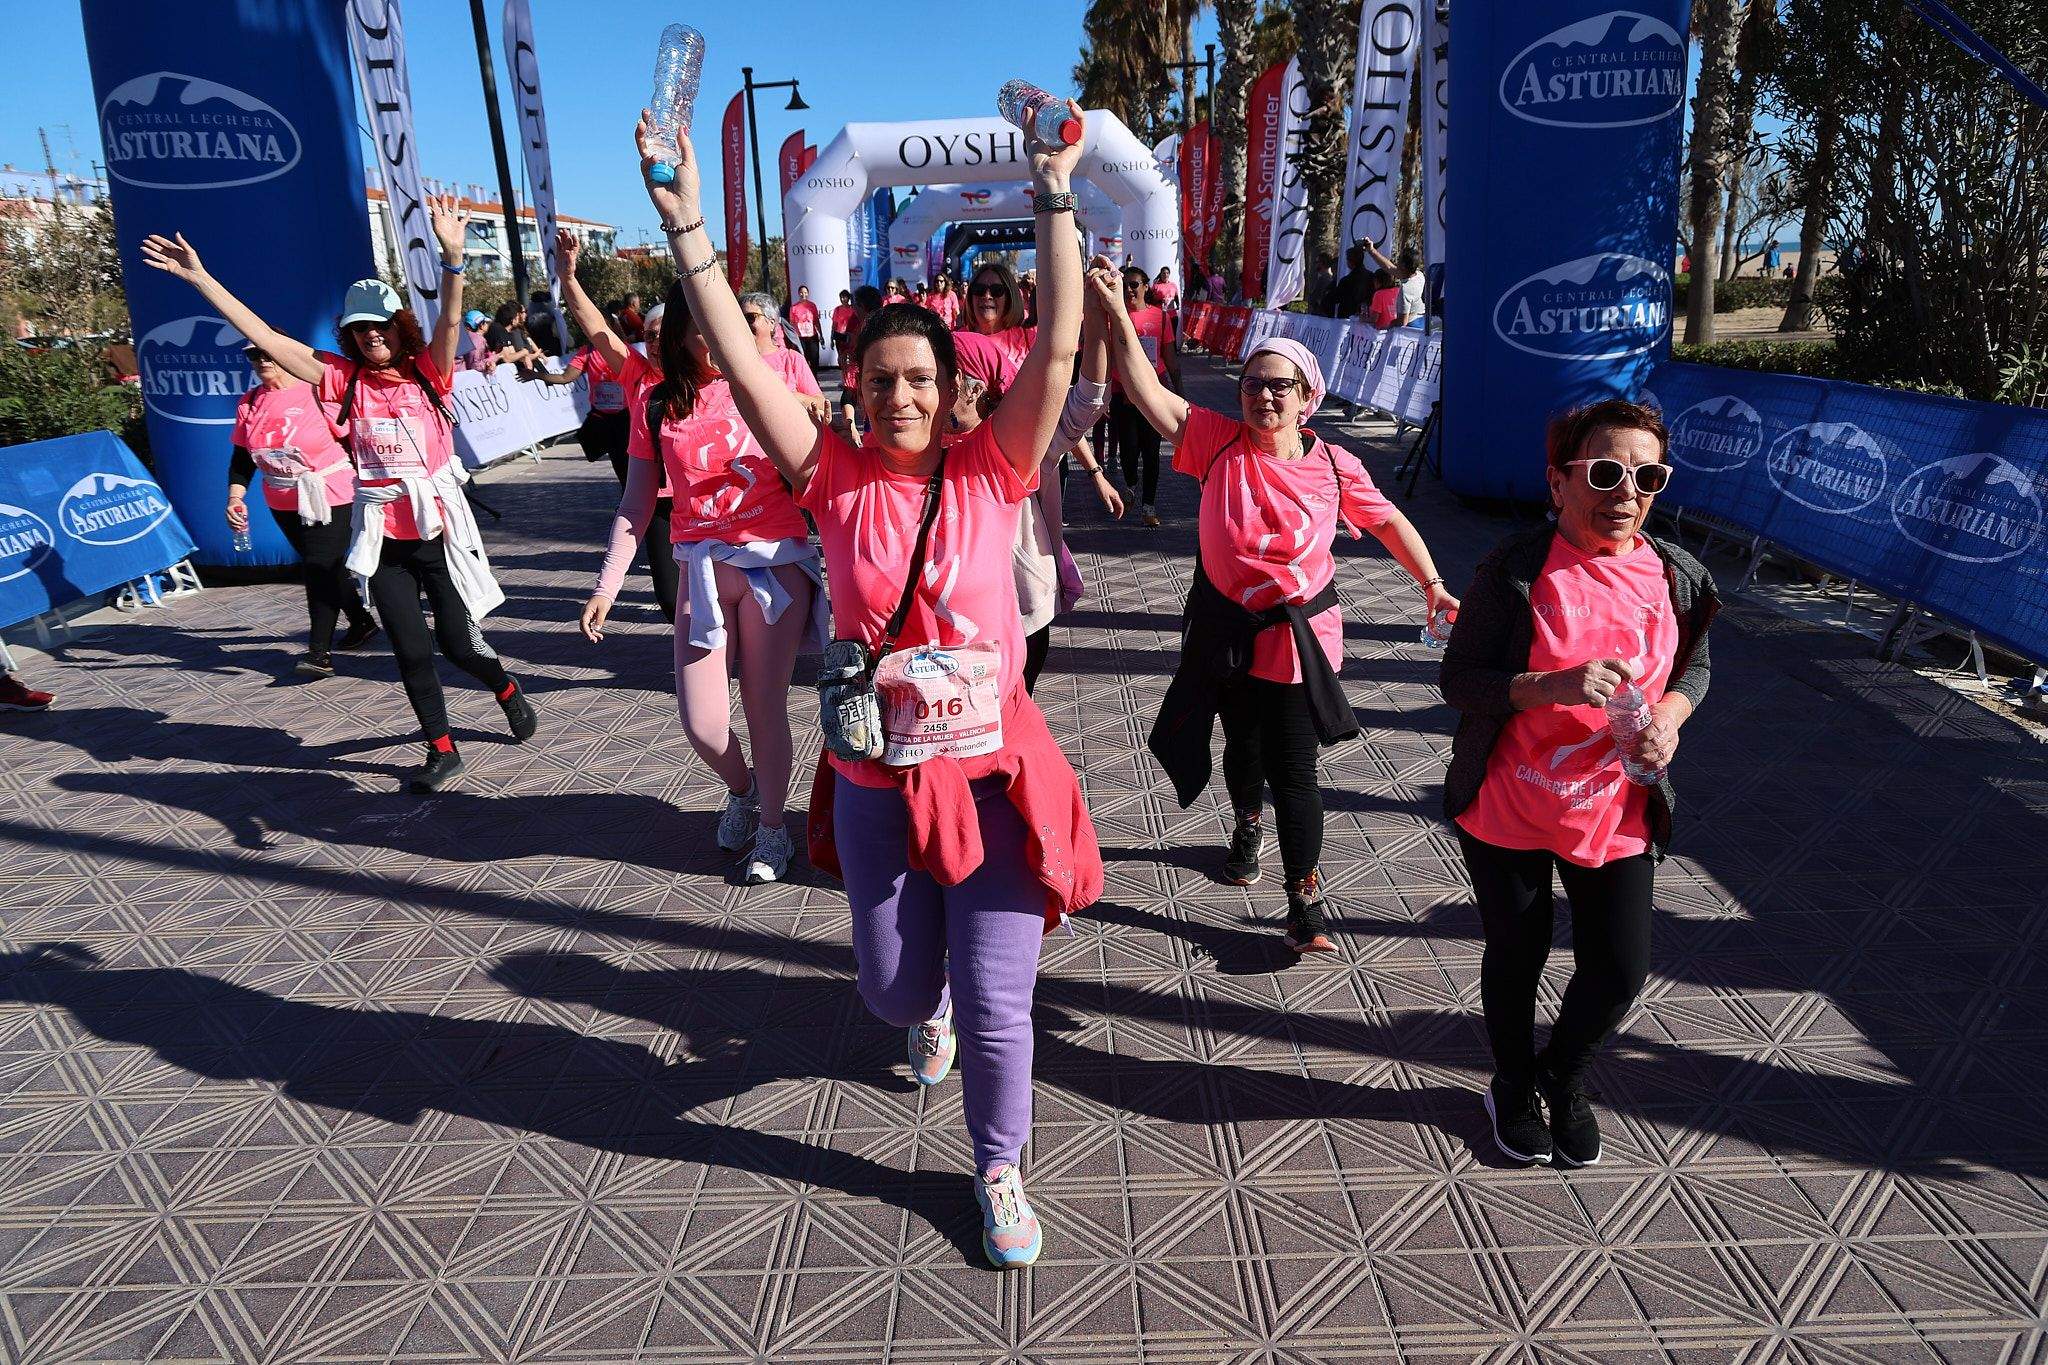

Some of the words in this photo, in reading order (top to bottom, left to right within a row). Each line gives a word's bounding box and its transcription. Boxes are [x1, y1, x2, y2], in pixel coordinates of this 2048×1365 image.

[1551, 52, 1627, 68] CENTRAL
[1514, 62, 1682, 106] ASTURIANA
[117, 112, 183, 127] CENTRAL
[190, 112, 274, 129] LECHERA
[106, 119, 288, 163] ASTURIANA
[1258, 93, 1280, 194] Santander
[898, 131, 1029, 169] OYSH
[1102, 160, 1150, 174] OYSHO
[807, 177, 855, 189] OYSHO
[1190, 146, 1203, 218] Santander
[975, 227, 1035, 238] VOLV
[1130, 228, 1174, 241] OYSHO
[792, 244, 835, 257] OYSHO
[1507, 296, 1668, 335] ASTURIANA
[376, 444, 403, 455] 016
[69, 495, 168, 536] ASTURIANA
[914, 697, 963, 720] 016
[923, 722, 948, 733] 2458
[923, 735, 931, 743] LA
[932, 733, 954, 742] MUJER
[959, 726, 986, 738] VALENCIA
[949, 740, 988, 753] Santander
[1514, 764, 1570, 796] CARRERA
[1569, 797, 1594, 811] 2025
